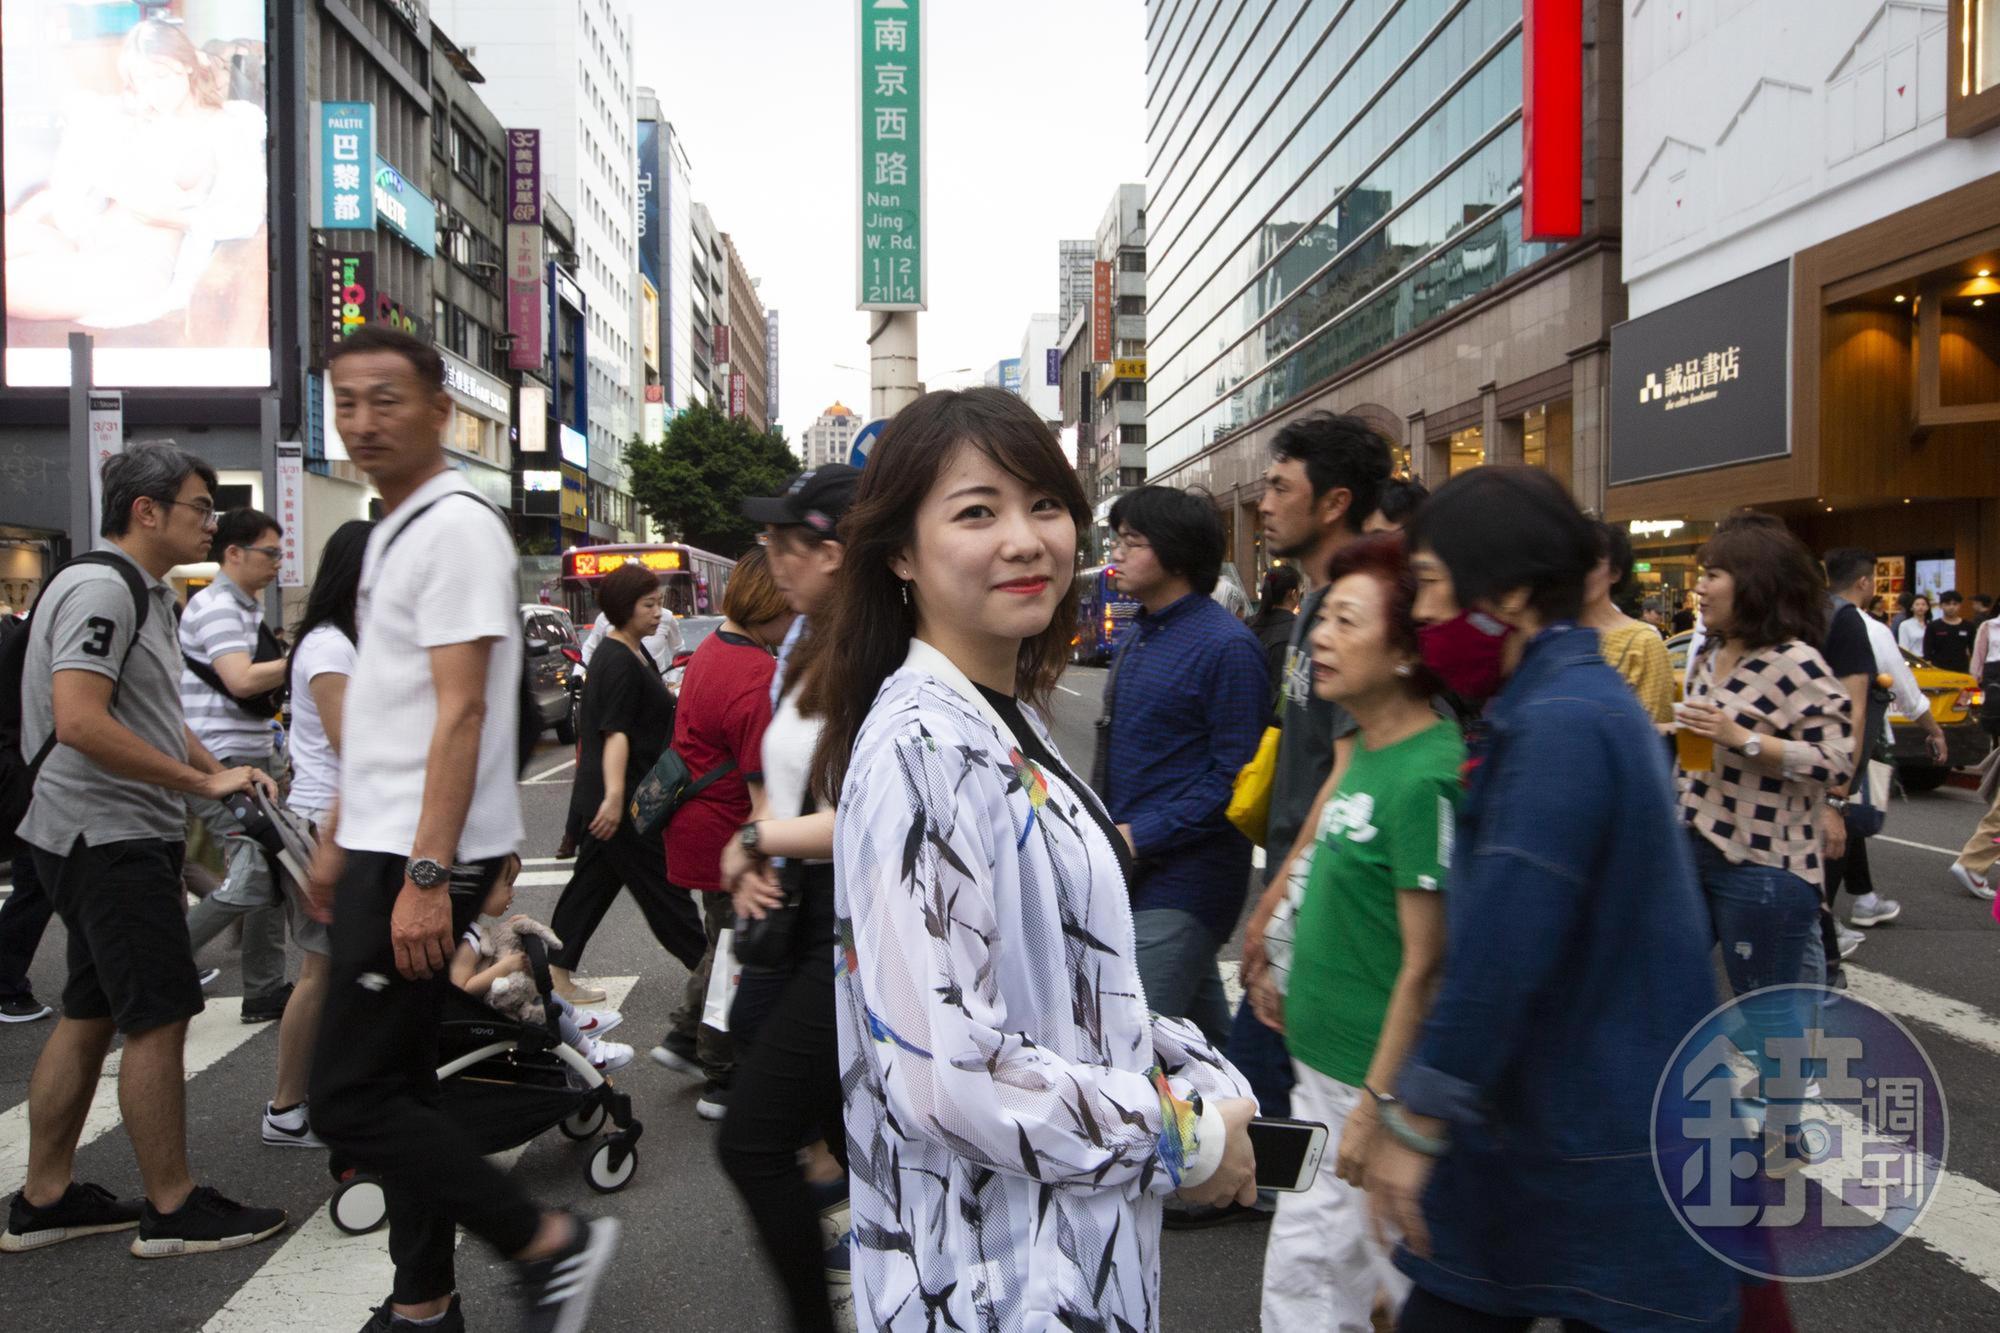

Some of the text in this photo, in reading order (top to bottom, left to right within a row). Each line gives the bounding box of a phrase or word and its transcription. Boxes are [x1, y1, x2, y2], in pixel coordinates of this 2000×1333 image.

[874, 17, 908, 186] 南京西路
[328, 118, 363, 129] PALETTE
[333, 134, 360, 220] 巴黎都
[867, 192, 900, 207] Nan
[867, 214, 903, 231] Jing
[867, 235, 916, 250] W. Rd.
[1665, 346, 1741, 397] 誠品書店
[94, 421, 118, 432] 3/31
[280, 465, 300, 474] 3/31
[575, 554, 597, 575] 52
[82, 616, 116, 658] 3
